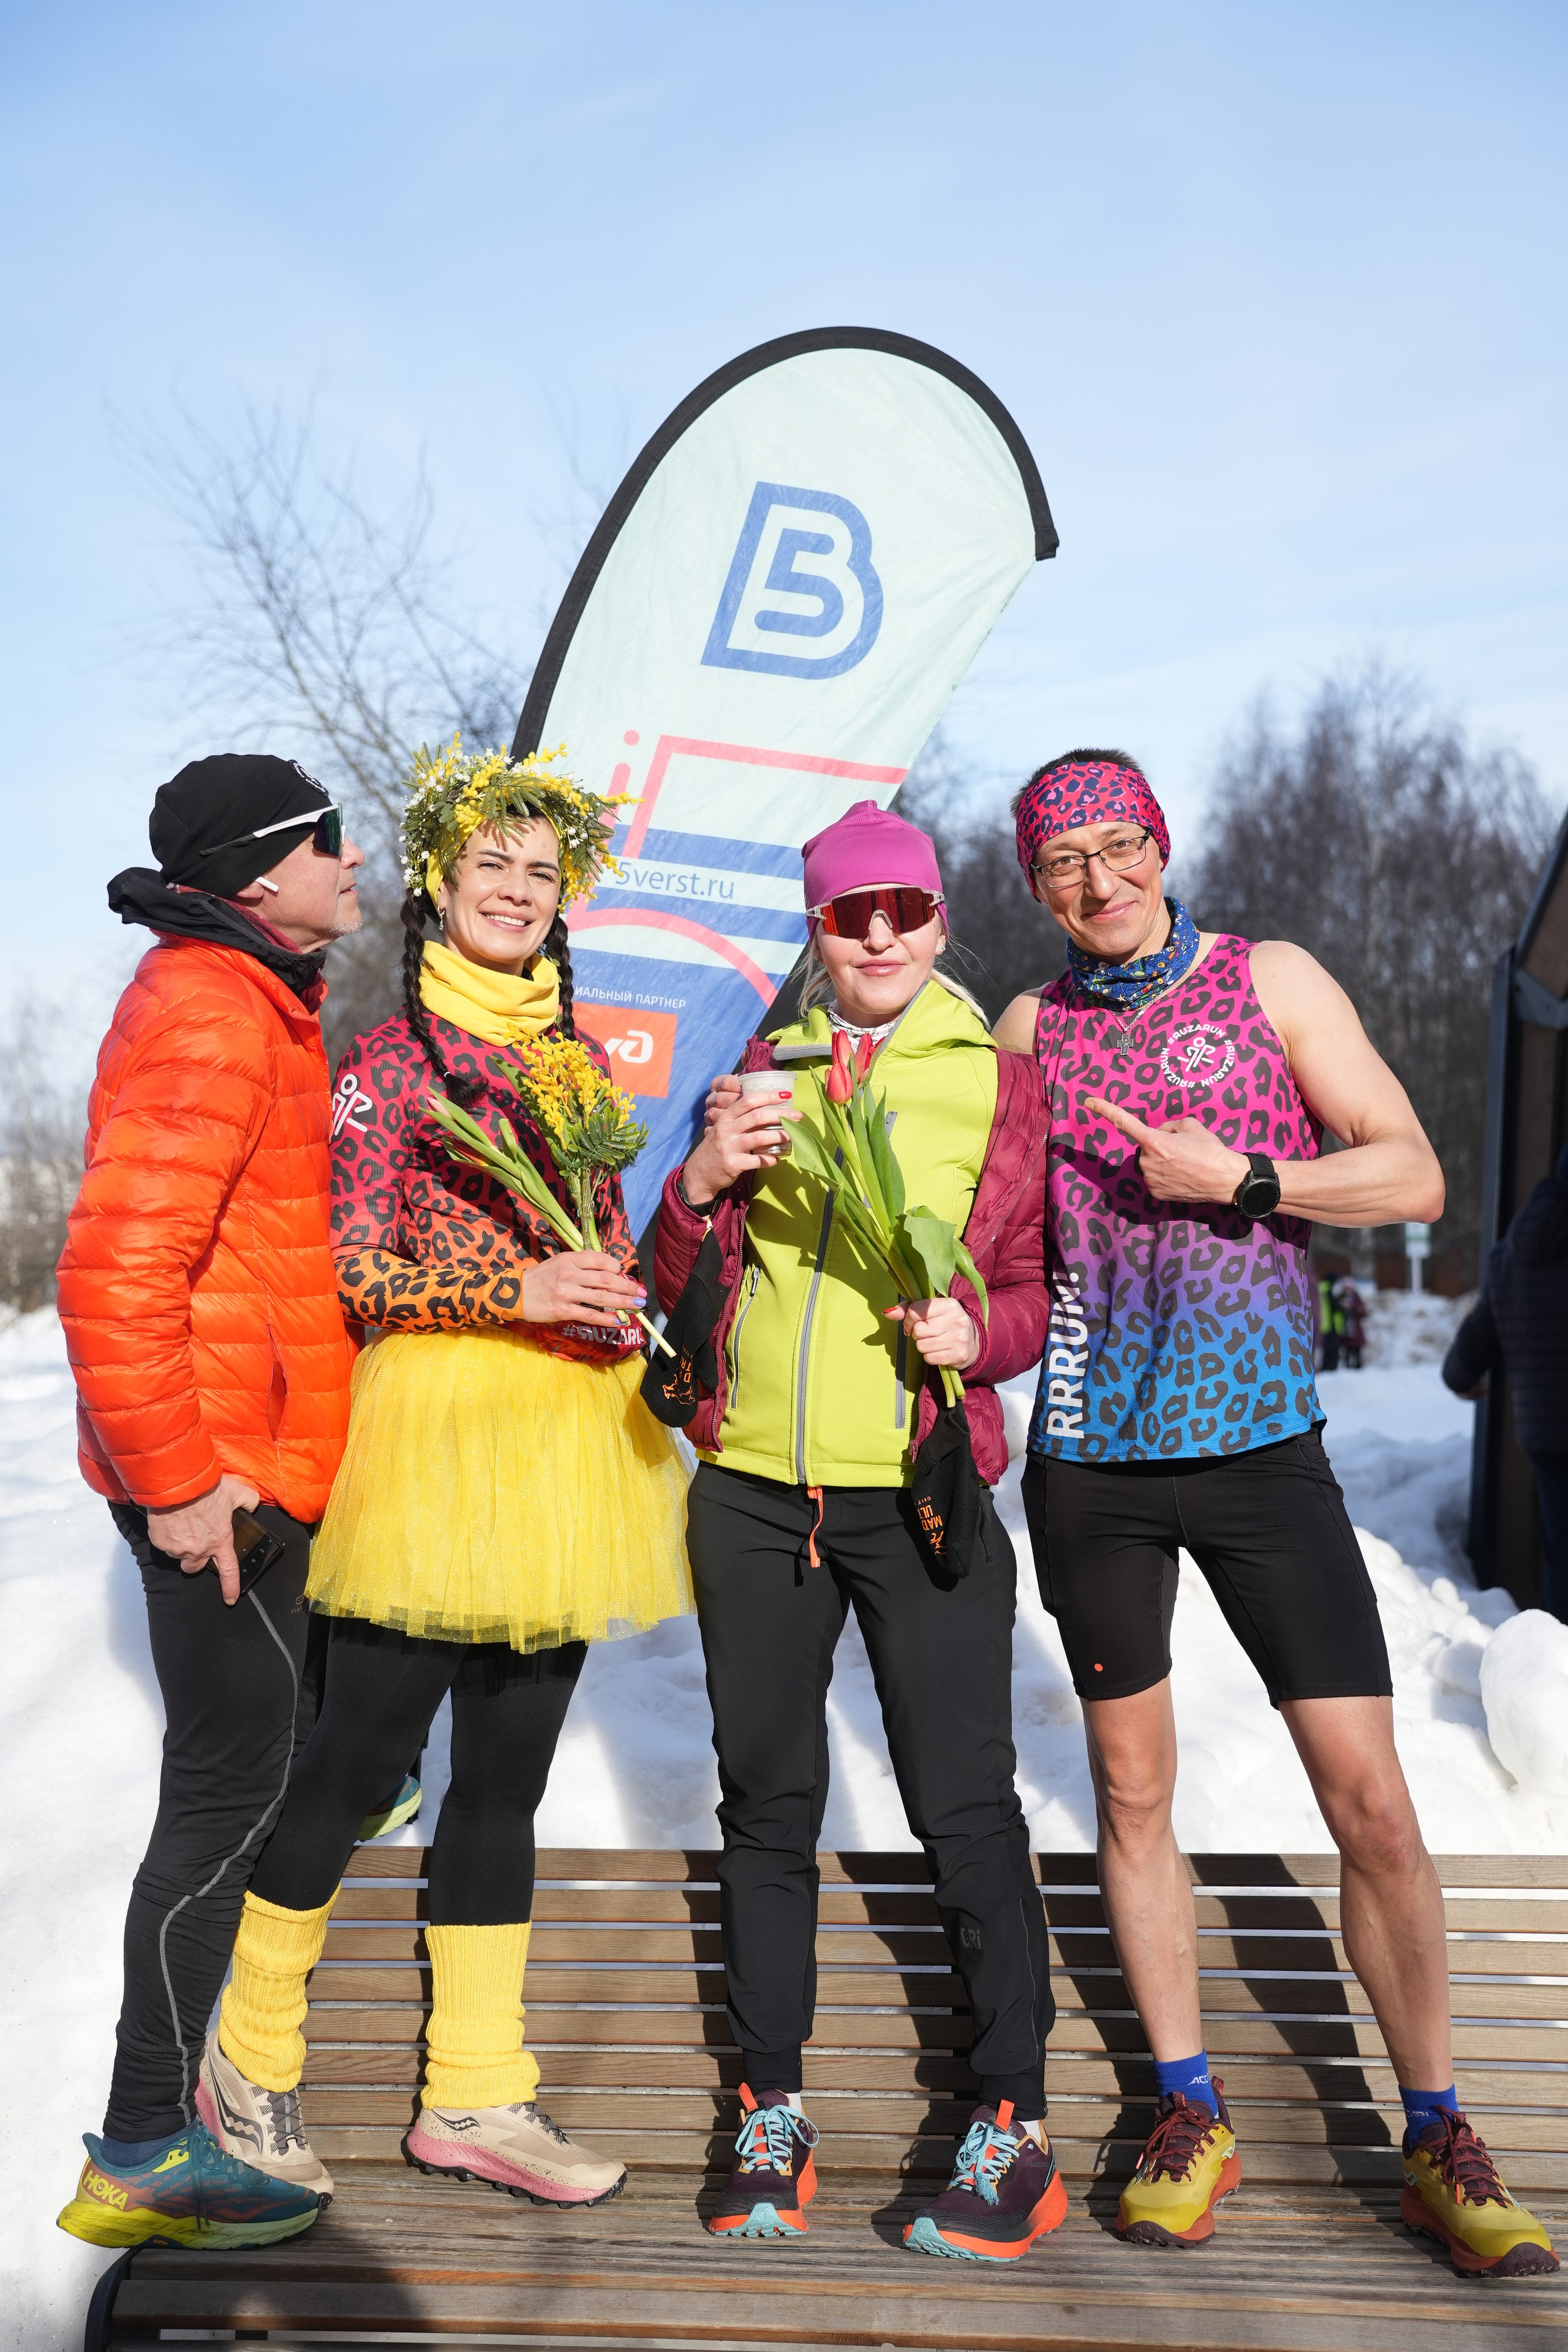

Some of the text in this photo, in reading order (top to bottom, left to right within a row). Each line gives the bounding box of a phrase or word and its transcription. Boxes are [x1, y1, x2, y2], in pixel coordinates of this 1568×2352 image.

[616, 861, 735, 899] 5verst.ru
[573, 986, 686, 1009] ИАЛЬНЫЙ ПАРТНЕР
[1046, 1272, 1089, 1439] RRRUN!
[921, 1515, 943, 1531] MAD
[83, 2169, 129, 2211] HOKA
